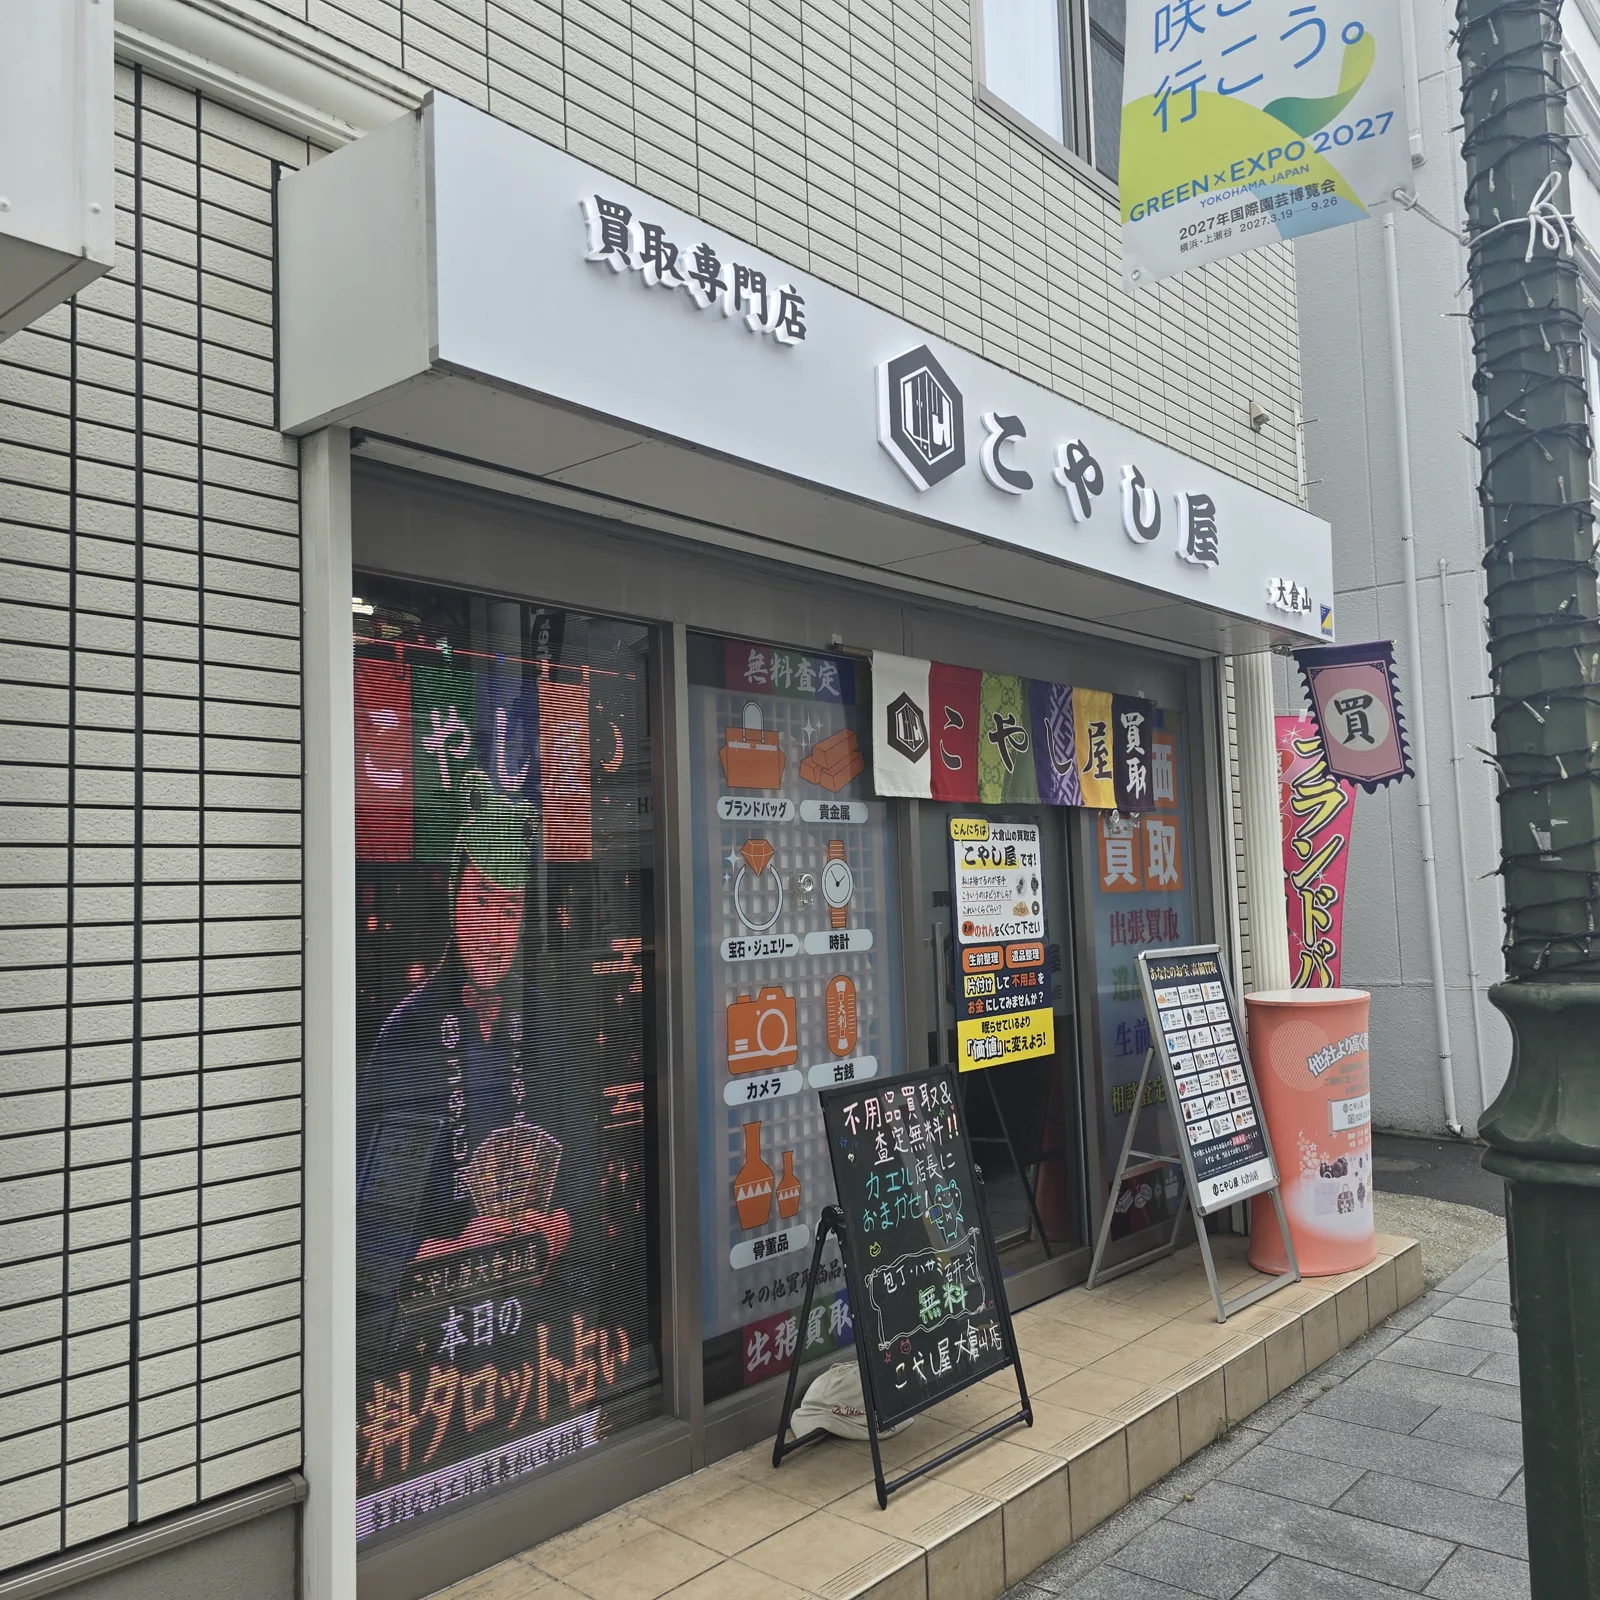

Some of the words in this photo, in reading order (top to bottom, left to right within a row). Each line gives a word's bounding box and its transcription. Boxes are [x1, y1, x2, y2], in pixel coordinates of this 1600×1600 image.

[1153, 5, 1364, 133] 行こう。
[1313, 111, 1394, 155] 2027
[1200, 178, 1266, 209] YOKOHAMA
[1270, 163, 1310, 185] JAPAN
[1179, 178, 1336, 241] 2027年国際園芸博覧会
[584, 194, 807, 343] 買取専門店
[982, 411, 1219, 568] こやし屋
[1269, 577, 1312, 614] 大倉山
[743, 648, 840, 697] 無料査定
[1333, 694, 1375, 745] 買
[939, 704, 1113, 781] こやし屋
[1120, 711, 1148, 799] 買取
[724, 798, 788, 819] ブランドバッグ
[819, 803, 851, 821] 貴金属
[953, 823, 987, 837] こんにちは
[991, 829, 1036, 842] 大倉山の買取店
[1103, 818, 1179, 887] 買取
[964, 845, 1017, 867] こやし屋
[728, 938, 794, 959] 宝石・ジュエリー
[829, 933, 850, 951] 時計
[1109, 907, 1180, 947] 出張買取
[968, 951, 999, 967] 生前整理
[1011, 948, 1040, 962] 遺品整理
[981, 1016, 1031, 1034] 眠らせているより
[746, 1078, 782, 1101] カメラ
[833, 1063, 854, 1082] 古銭
[843, 1081, 953, 1135] 不用品買取&
[865, 1153, 956, 1200] カエル店長に
[863, 1189, 930, 1232] おまかせ!
[753, 1233, 789, 1261] 骨董品
[918, 1283, 969, 1325] 無料
[437, 1296, 523, 1361] 本日の
[747, 1298, 853, 1371] 出張買取
[356, 1312, 630, 1480] 料タロット占い
